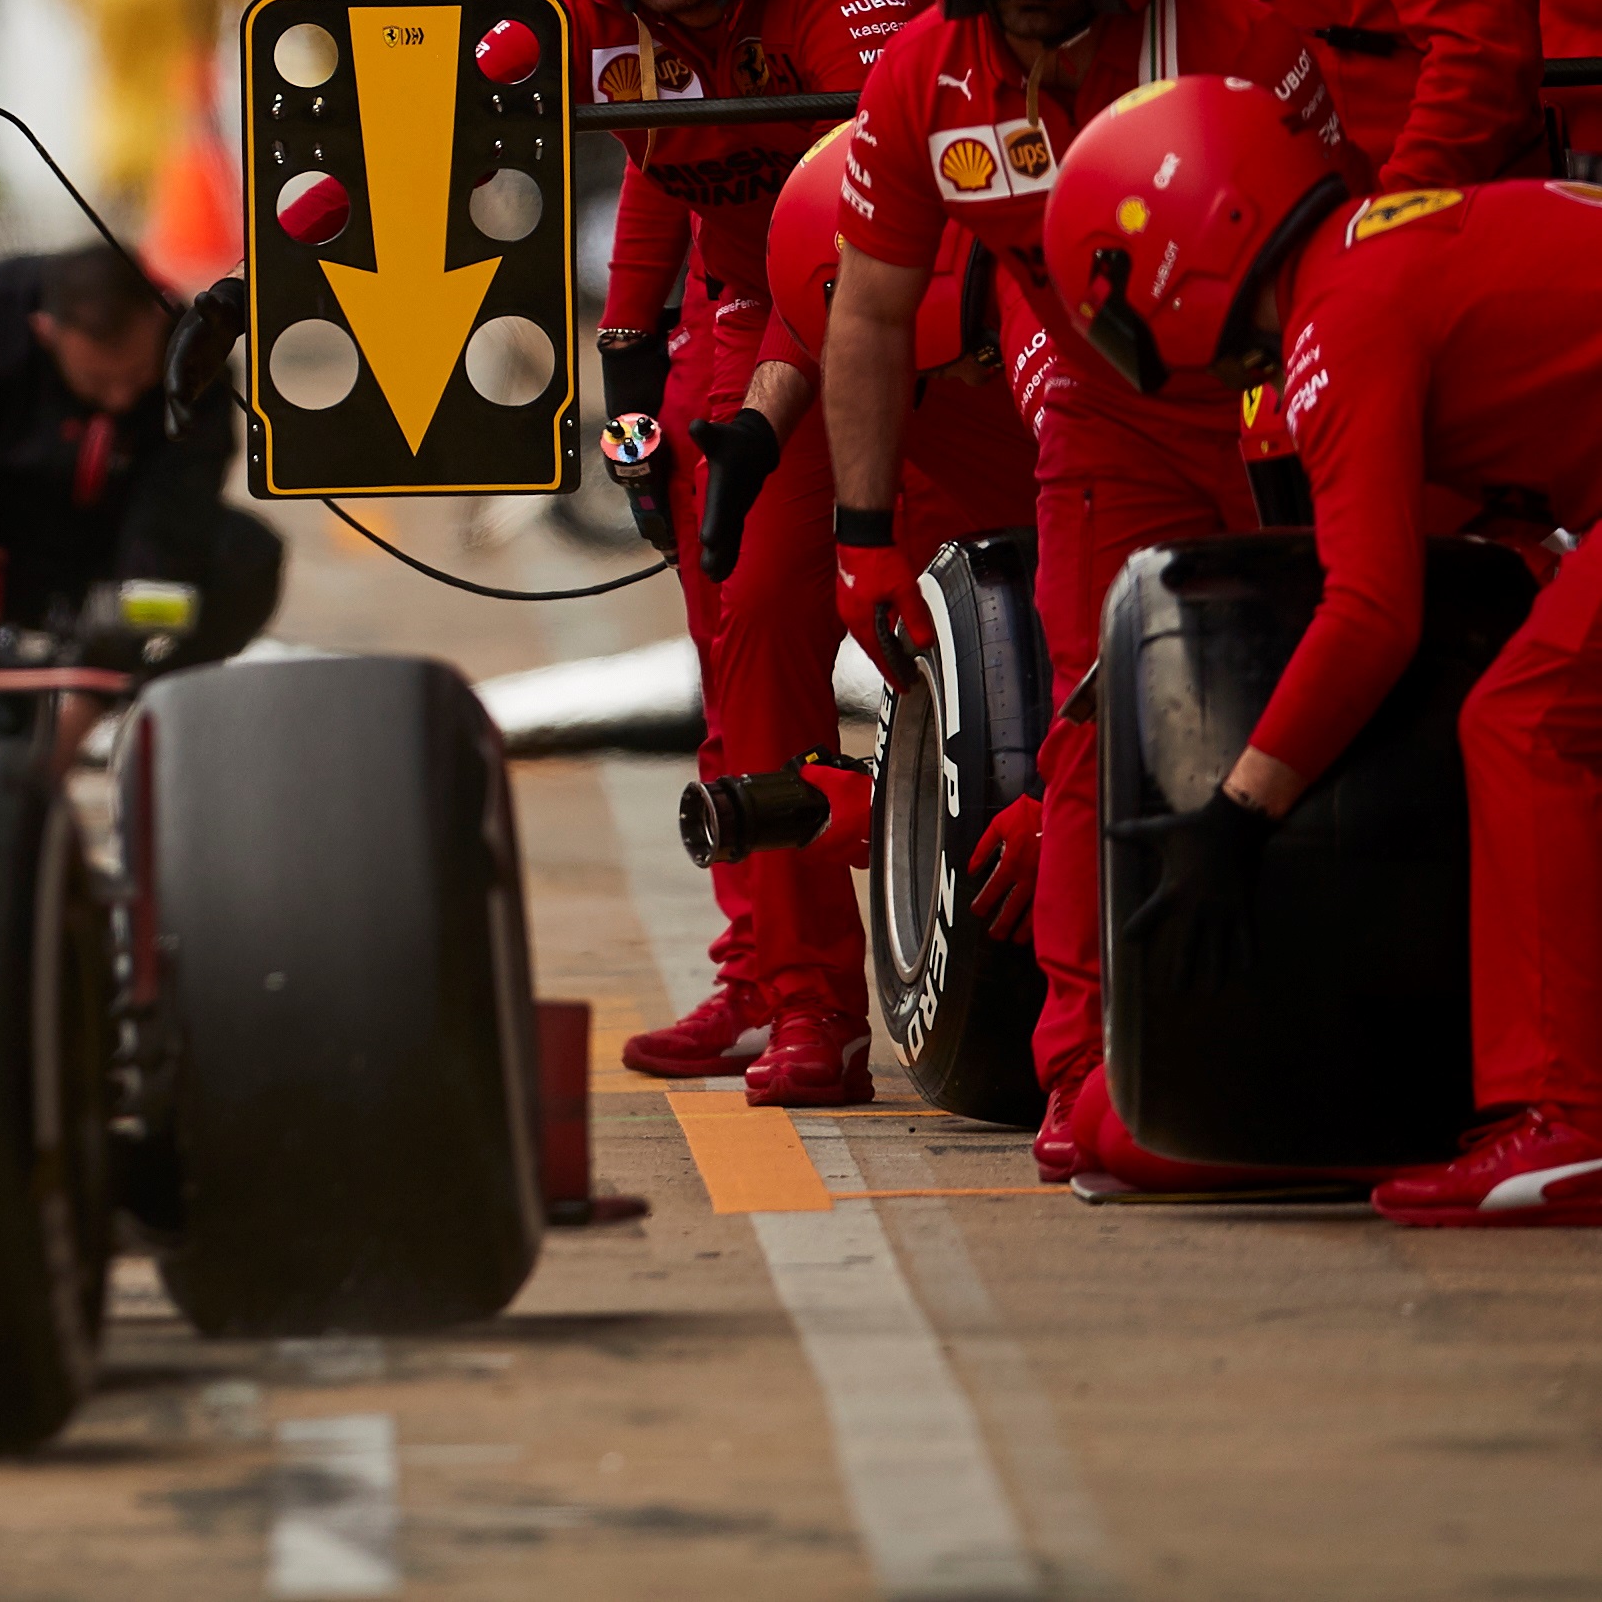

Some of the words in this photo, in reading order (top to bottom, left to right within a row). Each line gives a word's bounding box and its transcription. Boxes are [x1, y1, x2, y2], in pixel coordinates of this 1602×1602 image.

[849, 20, 908, 39] kasper
[655, 58, 691, 88] ups
[1009, 143, 1047, 174] ups
[1151, 240, 1179, 298] HUBLOT
[943, 754, 960, 818] P
[907, 849, 956, 1063] ZERO
